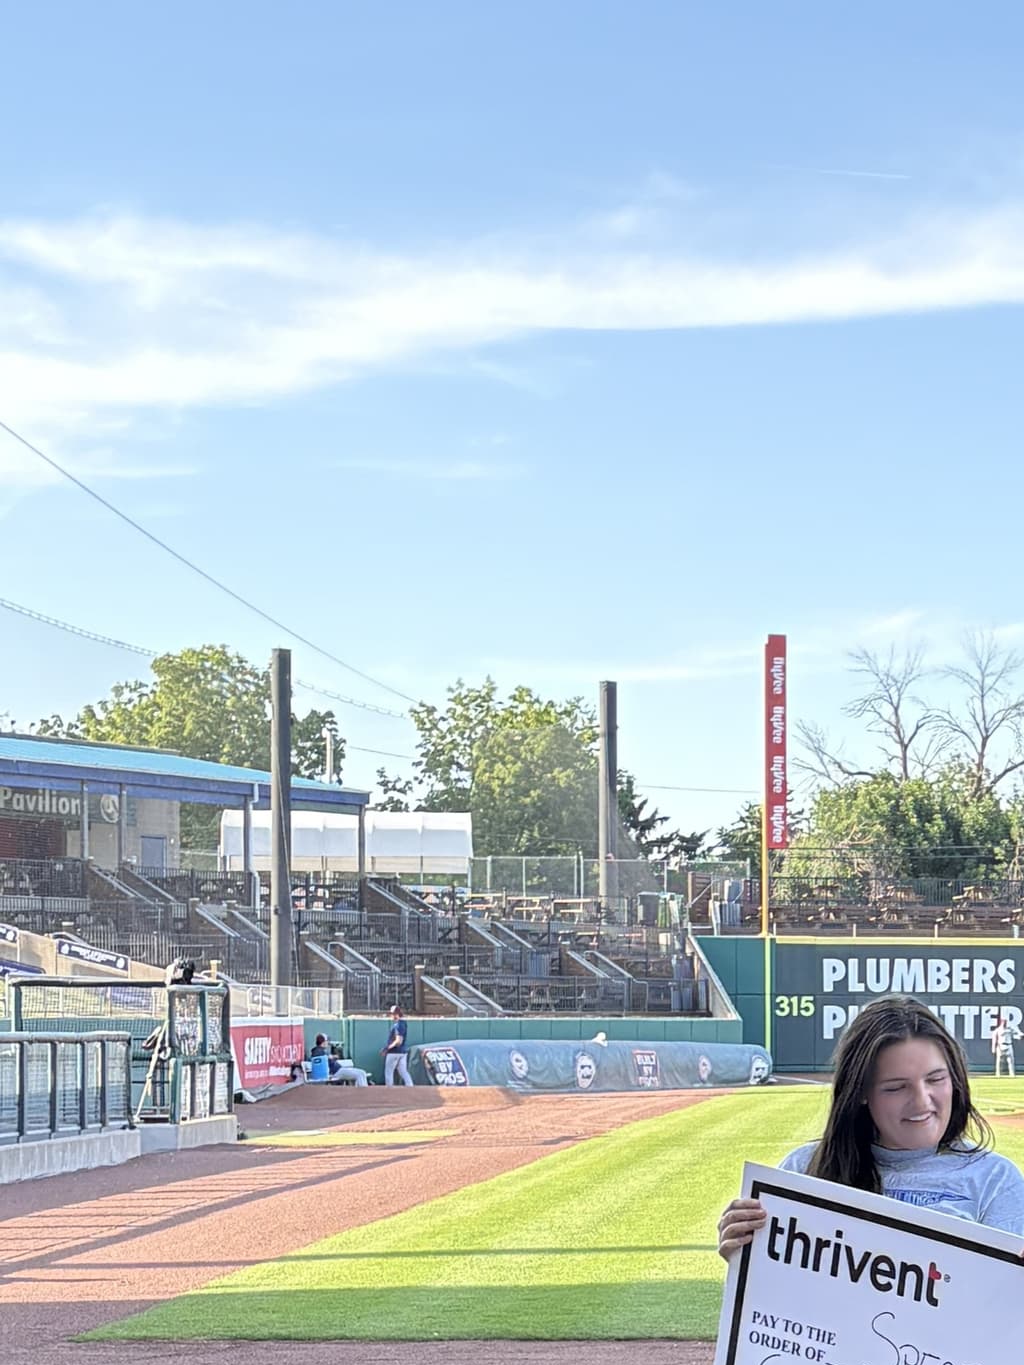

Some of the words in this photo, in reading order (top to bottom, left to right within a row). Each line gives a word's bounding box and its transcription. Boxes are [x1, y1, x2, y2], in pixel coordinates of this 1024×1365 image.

[0, 787, 80, 815] Pavilion
[822, 958, 1016, 993] PLUMBERS
[775, 996, 815, 1017] 315
[767, 1216, 942, 1307] thrivent
[752, 1311, 780, 1329] PAY
[783, 1319, 803, 1336] TO
[806, 1326, 837, 1346] THE
[749, 1331, 801, 1356] ORDER
[804, 1346, 826, 1362] OF
